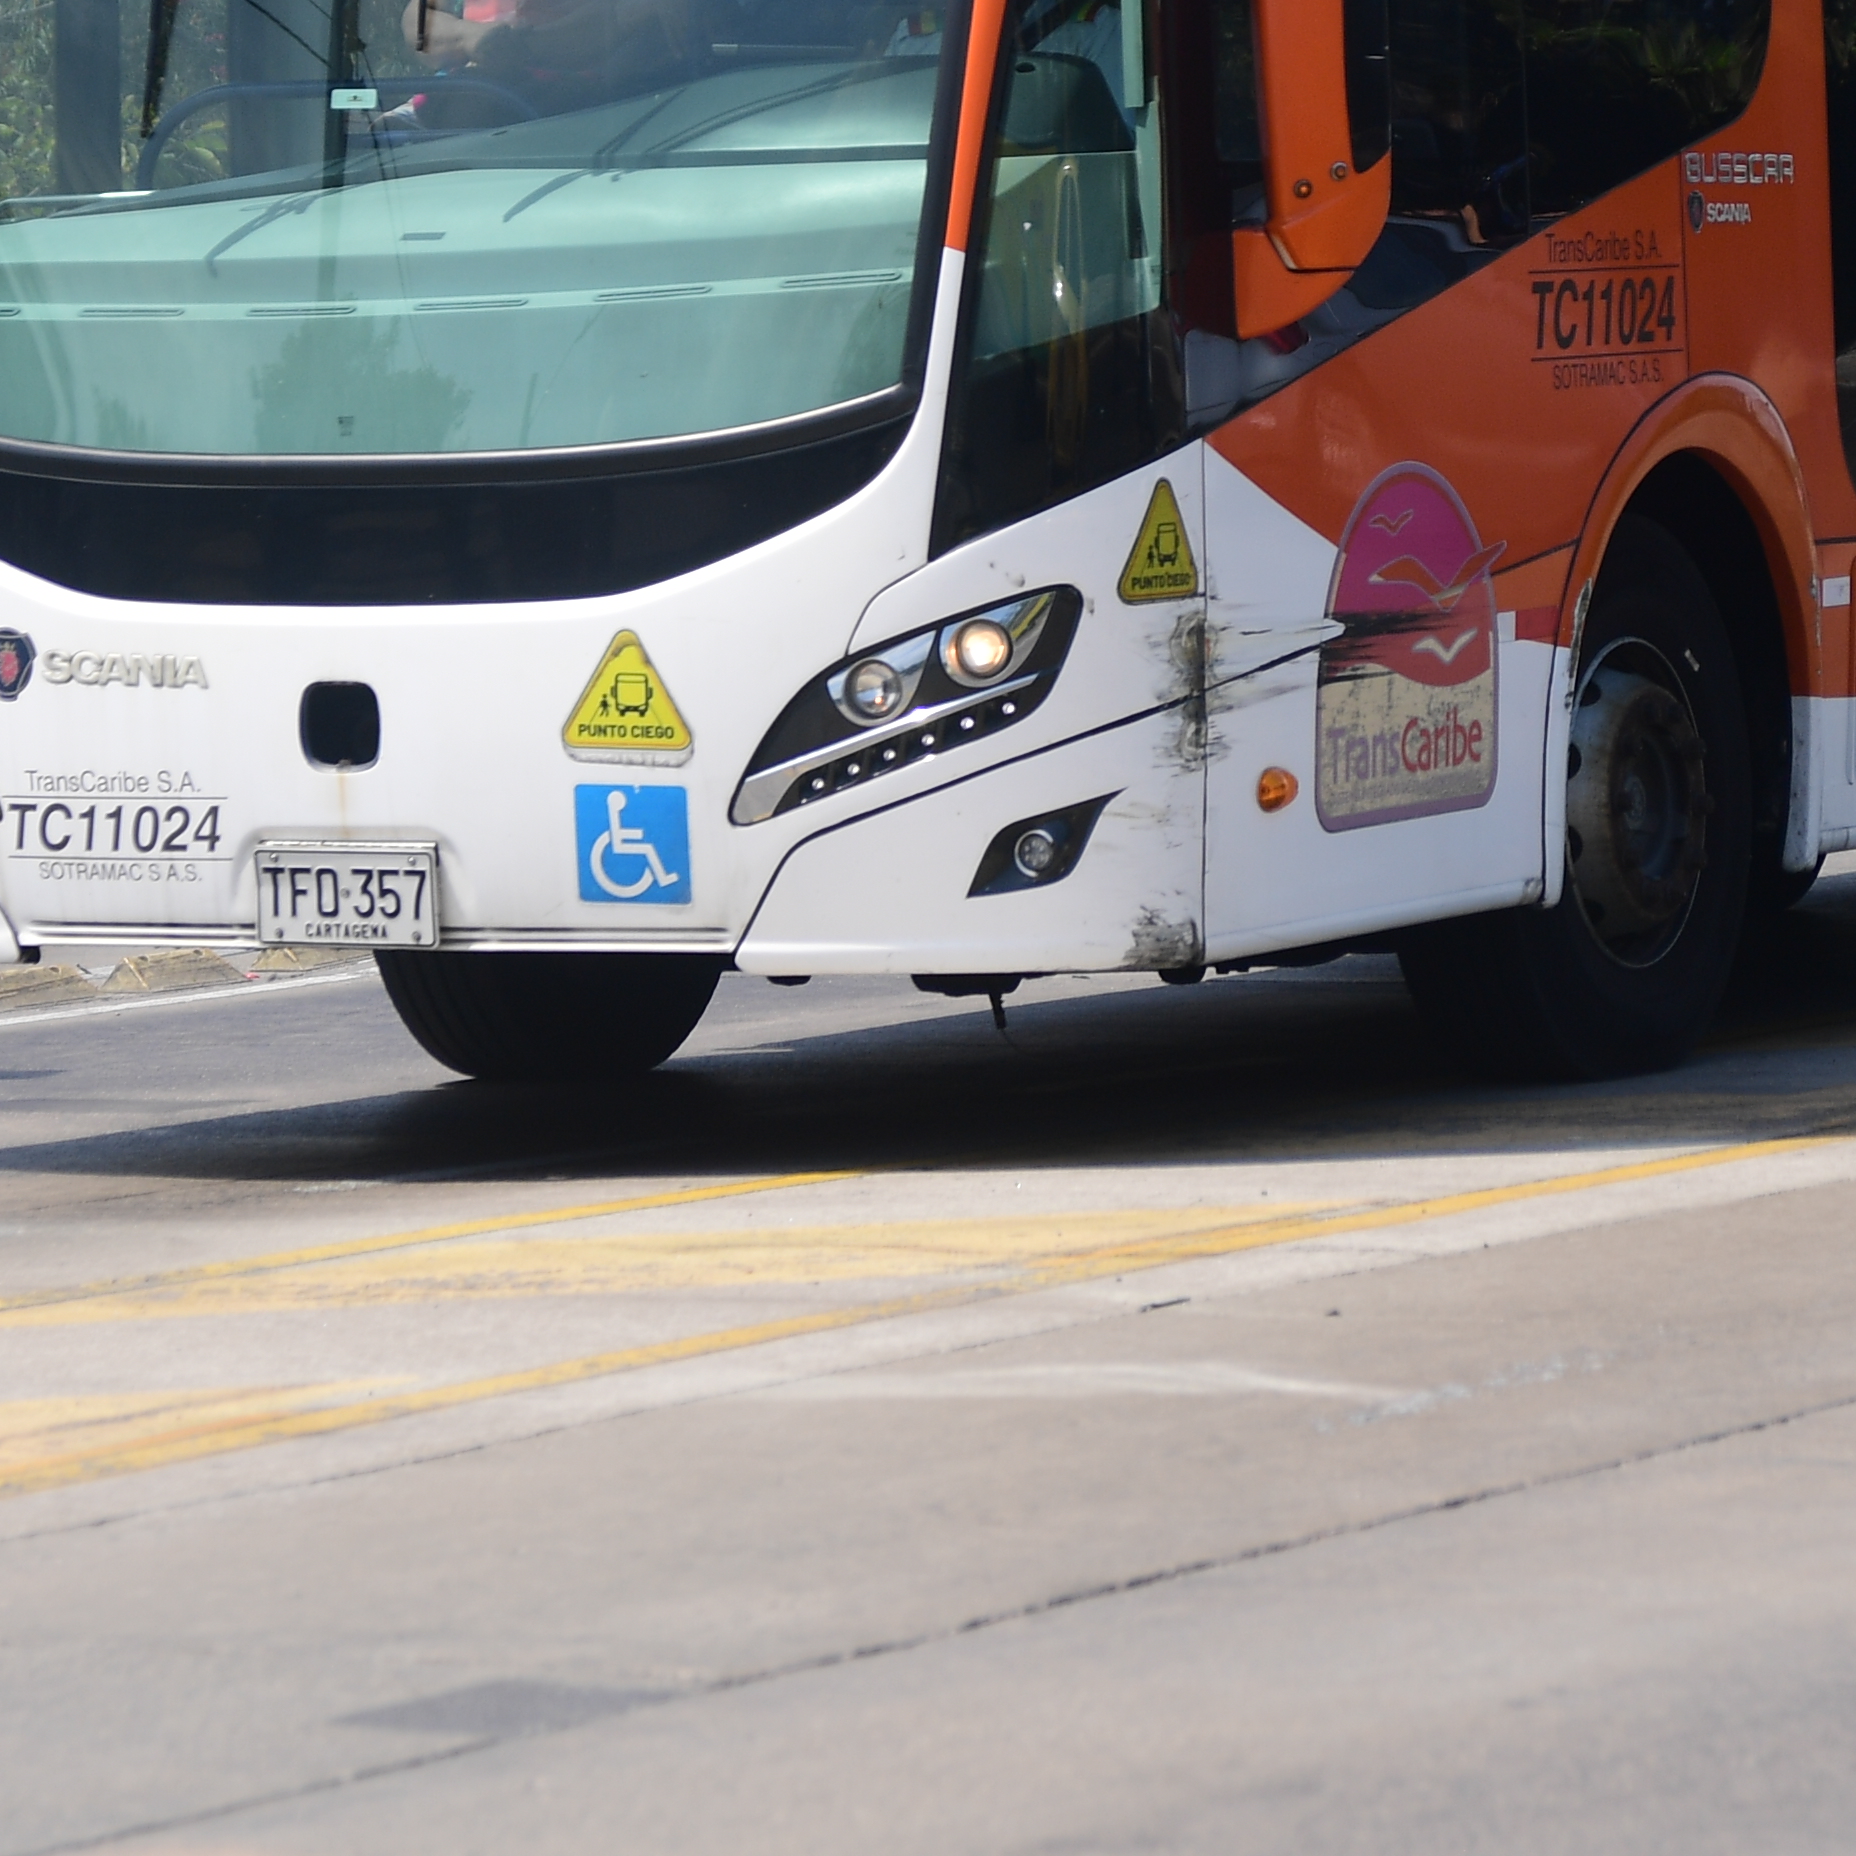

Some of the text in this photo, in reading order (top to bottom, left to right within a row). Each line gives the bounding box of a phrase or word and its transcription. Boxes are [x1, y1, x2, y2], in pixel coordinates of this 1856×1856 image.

[1685, 152, 1794, 184] BUSSCAR
[1707, 203, 1752, 224] SCANIA
[1545, 230, 1630, 263] TransCaribe
[1532, 275, 1676, 350] TC11024
[1553, 361, 1627, 390] SOTRAMAC
[1131, 576, 1165, 590] PUNTO
[43, 649, 210, 689] SCANIA
[578, 724, 675, 740] PUNTO CIEGO
[1327, 707, 1483, 785] TransCaribe
[24, 770, 202, 793] TransCaribe S.A.
[8, 803, 222, 853] TC11024
[38, 861, 143, 881] SOTRAMAC
[305, 922, 389, 940] CARTAGENA
